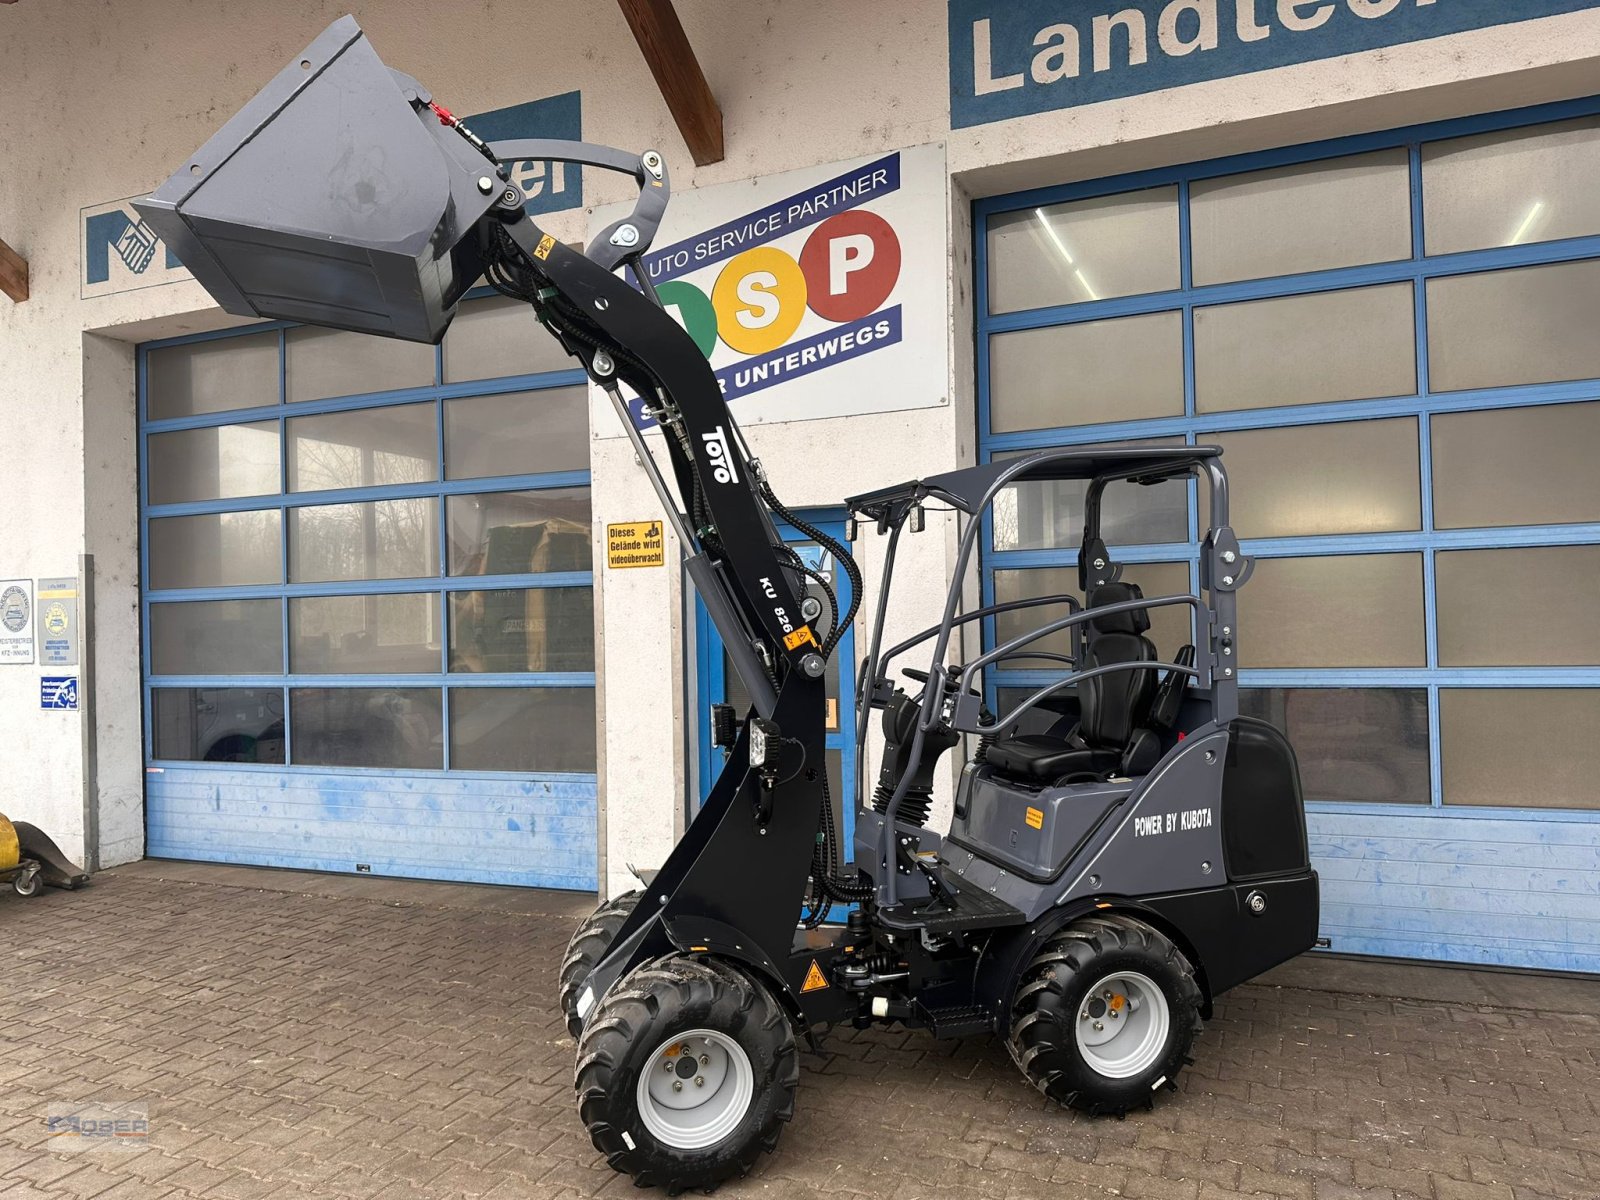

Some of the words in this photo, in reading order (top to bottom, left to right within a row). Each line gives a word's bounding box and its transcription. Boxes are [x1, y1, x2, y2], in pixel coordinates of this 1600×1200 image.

[648, 250, 689, 278] UTO
[695, 212, 782, 261] SERVICE
[788, 169, 888, 224] PARTNER
[735, 320, 890, 388] UNTERWEGS
[610, 528, 635, 538] Dieses
[610, 540, 641, 551] Gelände
[643, 539, 661, 549] wird
[611, 553, 661, 564] videoüberwacht
[759, 577, 777, 599] KU
[774, 606, 794, 633] 826
[1134, 814, 1163, 837] POWER
[1166, 813, 1178, 833] BY
[1181, 808, 1212, 831] KUBOTA
